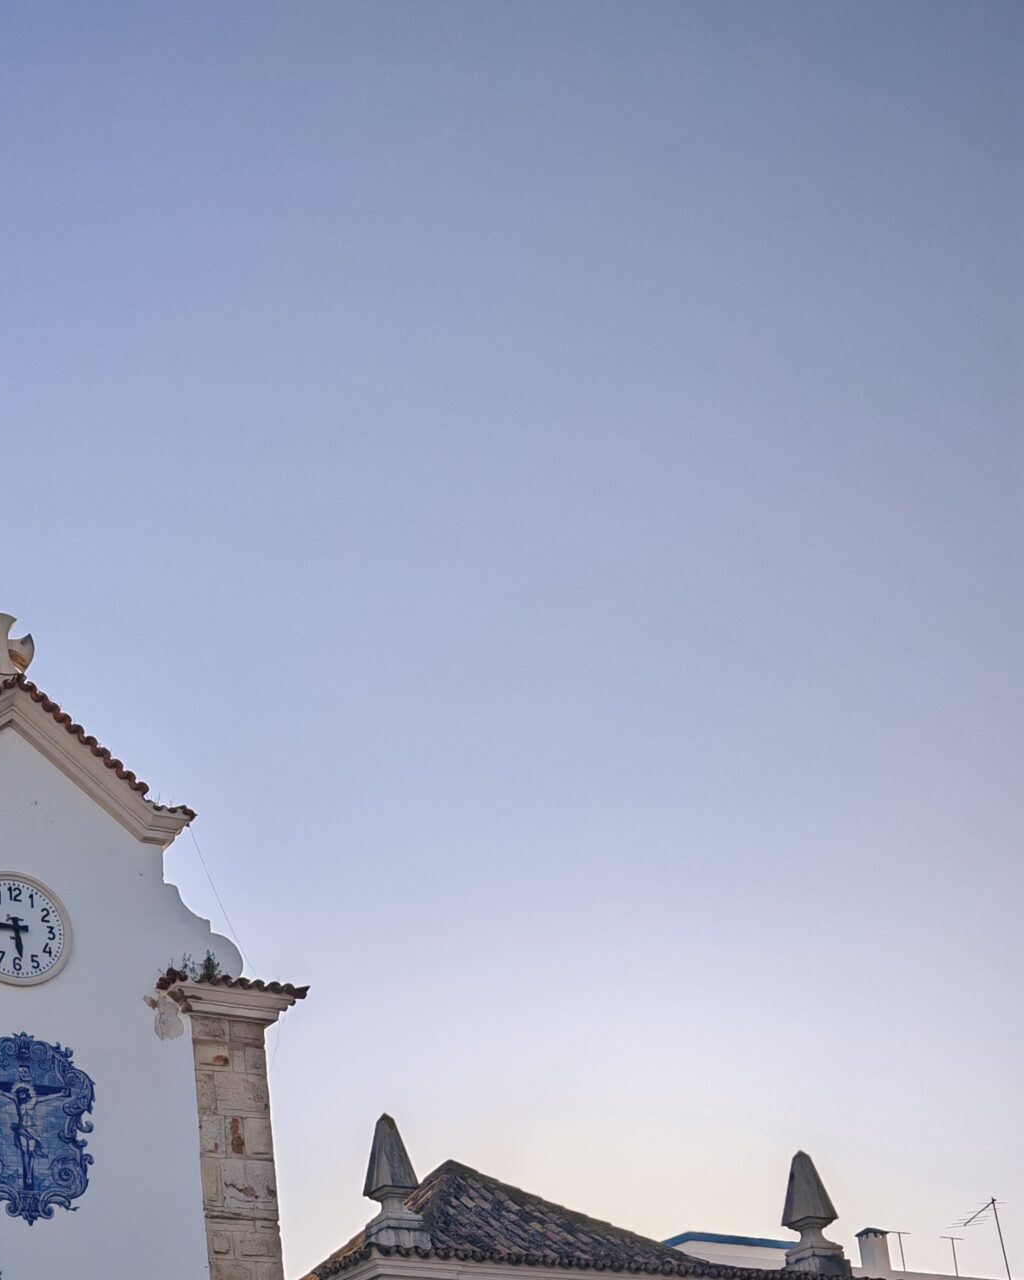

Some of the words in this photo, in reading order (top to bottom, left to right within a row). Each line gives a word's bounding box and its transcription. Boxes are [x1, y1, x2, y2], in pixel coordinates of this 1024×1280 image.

[7, 886, 22, 902] 12
[28, 893, 34, 908] 1
[41, 908, 50, 923] 2
[46, 925, 56, 941] 3
[42, 942, 52, 957] 4
[13, 957, 22, 971] 6
[31, 954, 40, 969] 5
